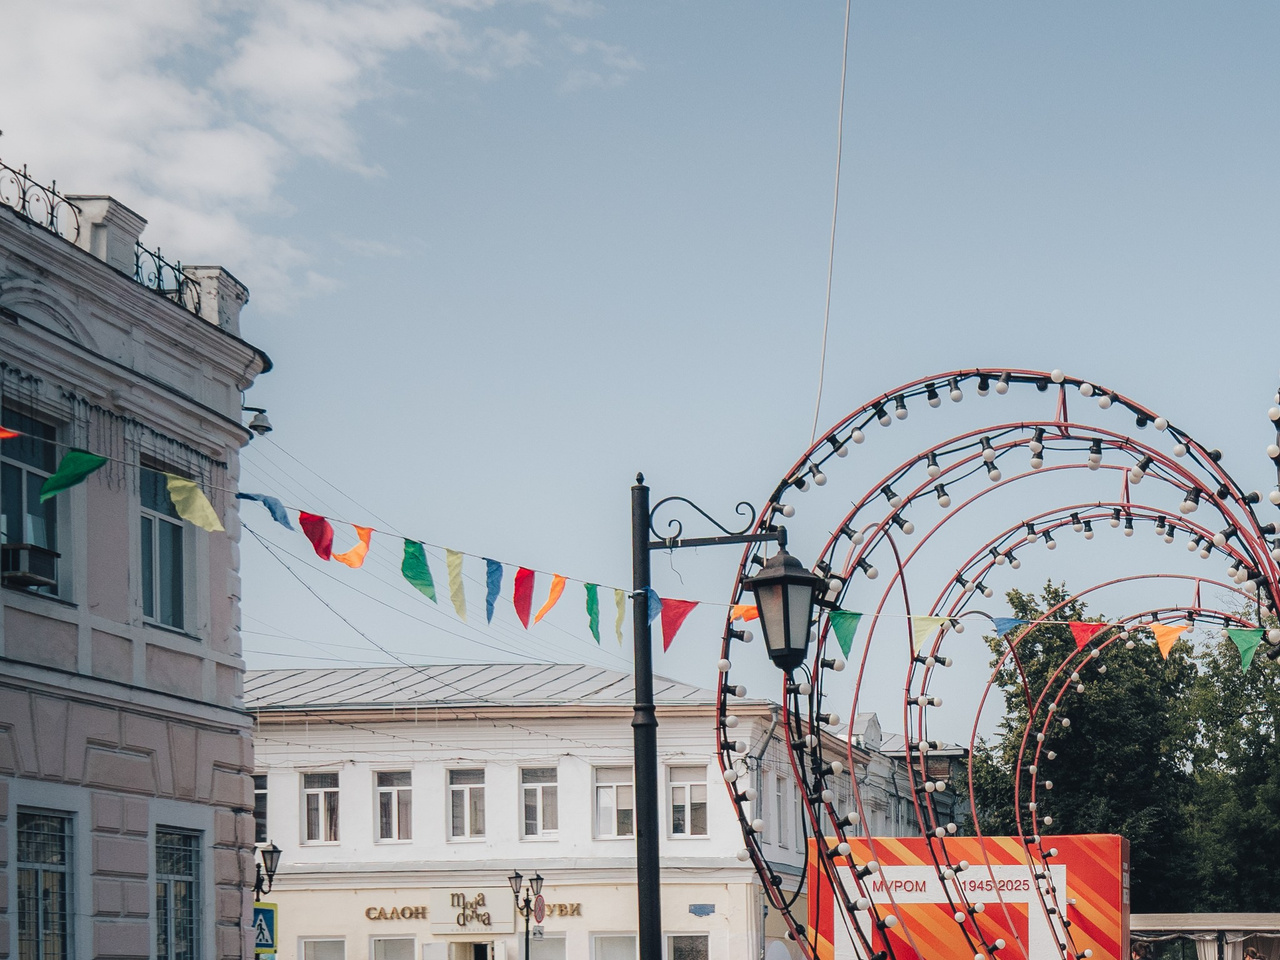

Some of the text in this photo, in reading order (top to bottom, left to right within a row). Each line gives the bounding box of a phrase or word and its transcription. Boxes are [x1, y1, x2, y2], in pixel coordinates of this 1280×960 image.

[872, 880, 926, 892] МУРОМ
[365, 903, 582, 920] САЛОН ОУВИ
